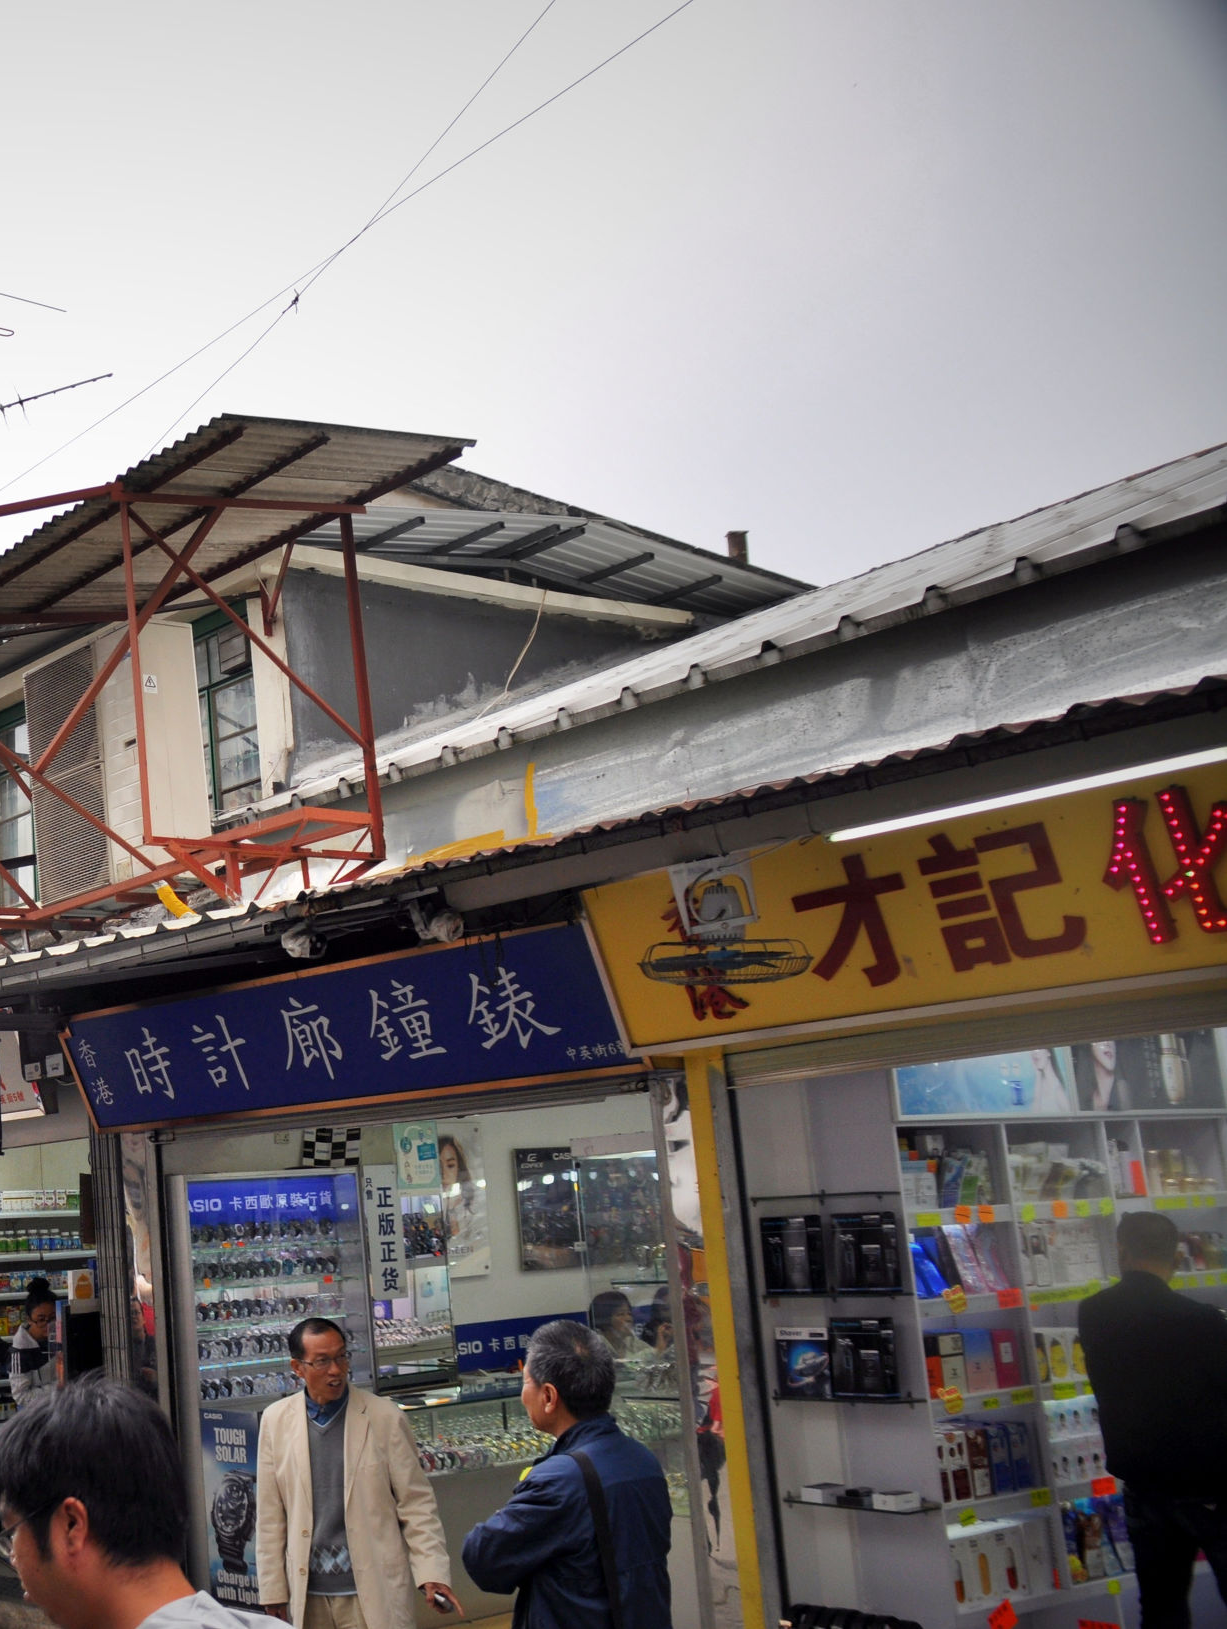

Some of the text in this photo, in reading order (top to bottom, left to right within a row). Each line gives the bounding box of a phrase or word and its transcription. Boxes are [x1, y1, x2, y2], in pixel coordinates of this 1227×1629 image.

[78, 1039, 115, 1105] 香港
[552, 1152, 571, 1160] CAS
[376, 1187, 400, 1292] 正版正货
[203, 1412, 223, 1420] CASIO
[214, 1427, 246, 1447] TOUGH
[215, 1446, 248, 1464] SOLAR
[217, 1569, 250, 1588] Charge
[216, 1585, 237, 1601] with
